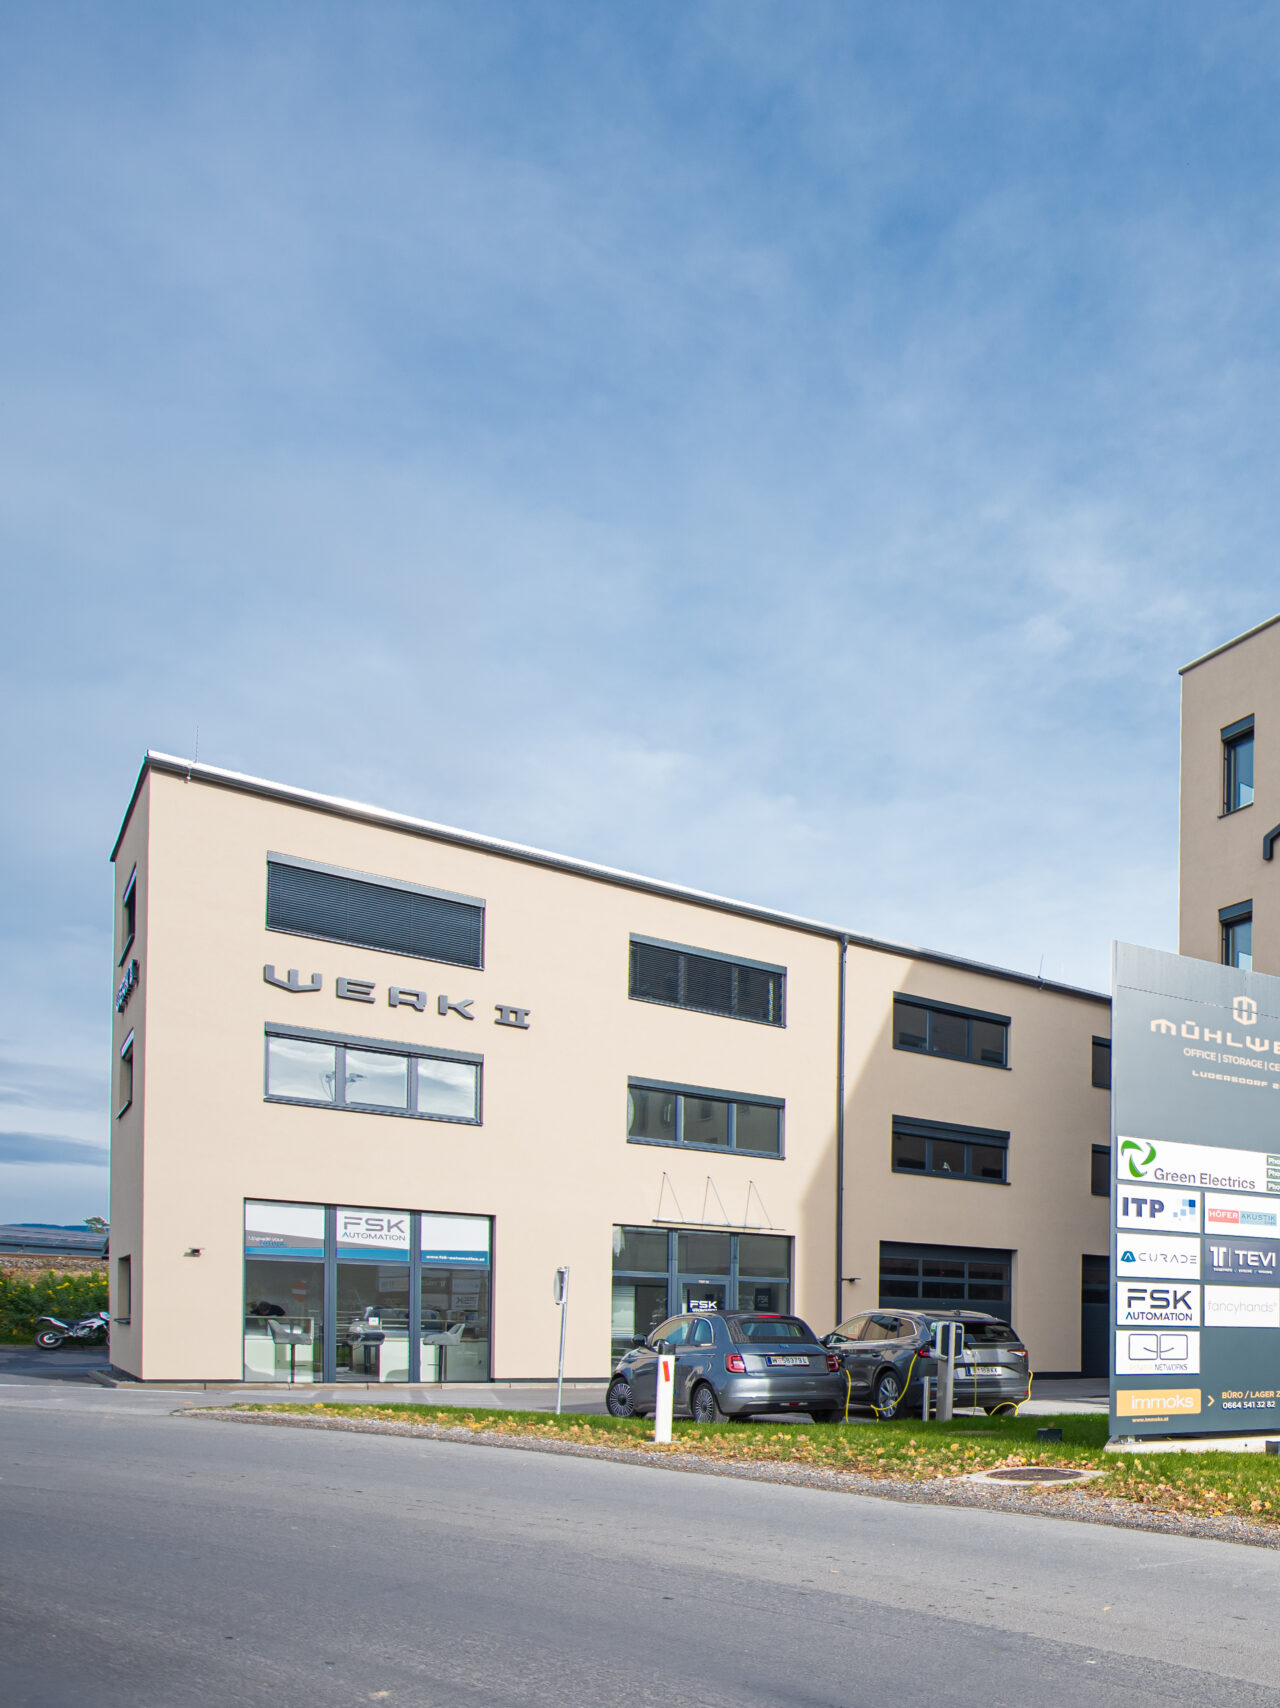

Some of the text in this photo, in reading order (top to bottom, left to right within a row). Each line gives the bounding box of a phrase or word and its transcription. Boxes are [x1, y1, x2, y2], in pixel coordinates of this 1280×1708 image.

[263, 963, 531, 1030] WERK II
[1183, 1047, 1217, 1061] OFFICE
[1222, 1054, 1264, 1069] STORAGE
[1154, 1167, 1256, 1190] Green Electrics
[1122, 1196, 1165, 1219] ITP
[1209, 1209, 1276, 1223] HÖFER AKUSTIK
[343, 1215, 406, 1234] FSK
[342, 1231, 407, 1242] AUTOMATION
[1234, 1250, 1277, 1268] TEVI
[689, 1300, 718, 1309] FSK
[1127, 1288, 1193, 1310] FSK
[1125, 1311, 1193, 1321] AUTOMATION
[1154, 1363, 1188, 1372] NETWORKS
[1131, 1395, 1195, 1410] immoks
[1221, 1390, 1244, 1400] BÜRO
[1250, 1390, 1275, 1399] LAGER
[1222, 1401, 1276, 1410] 0664 541 32 82
